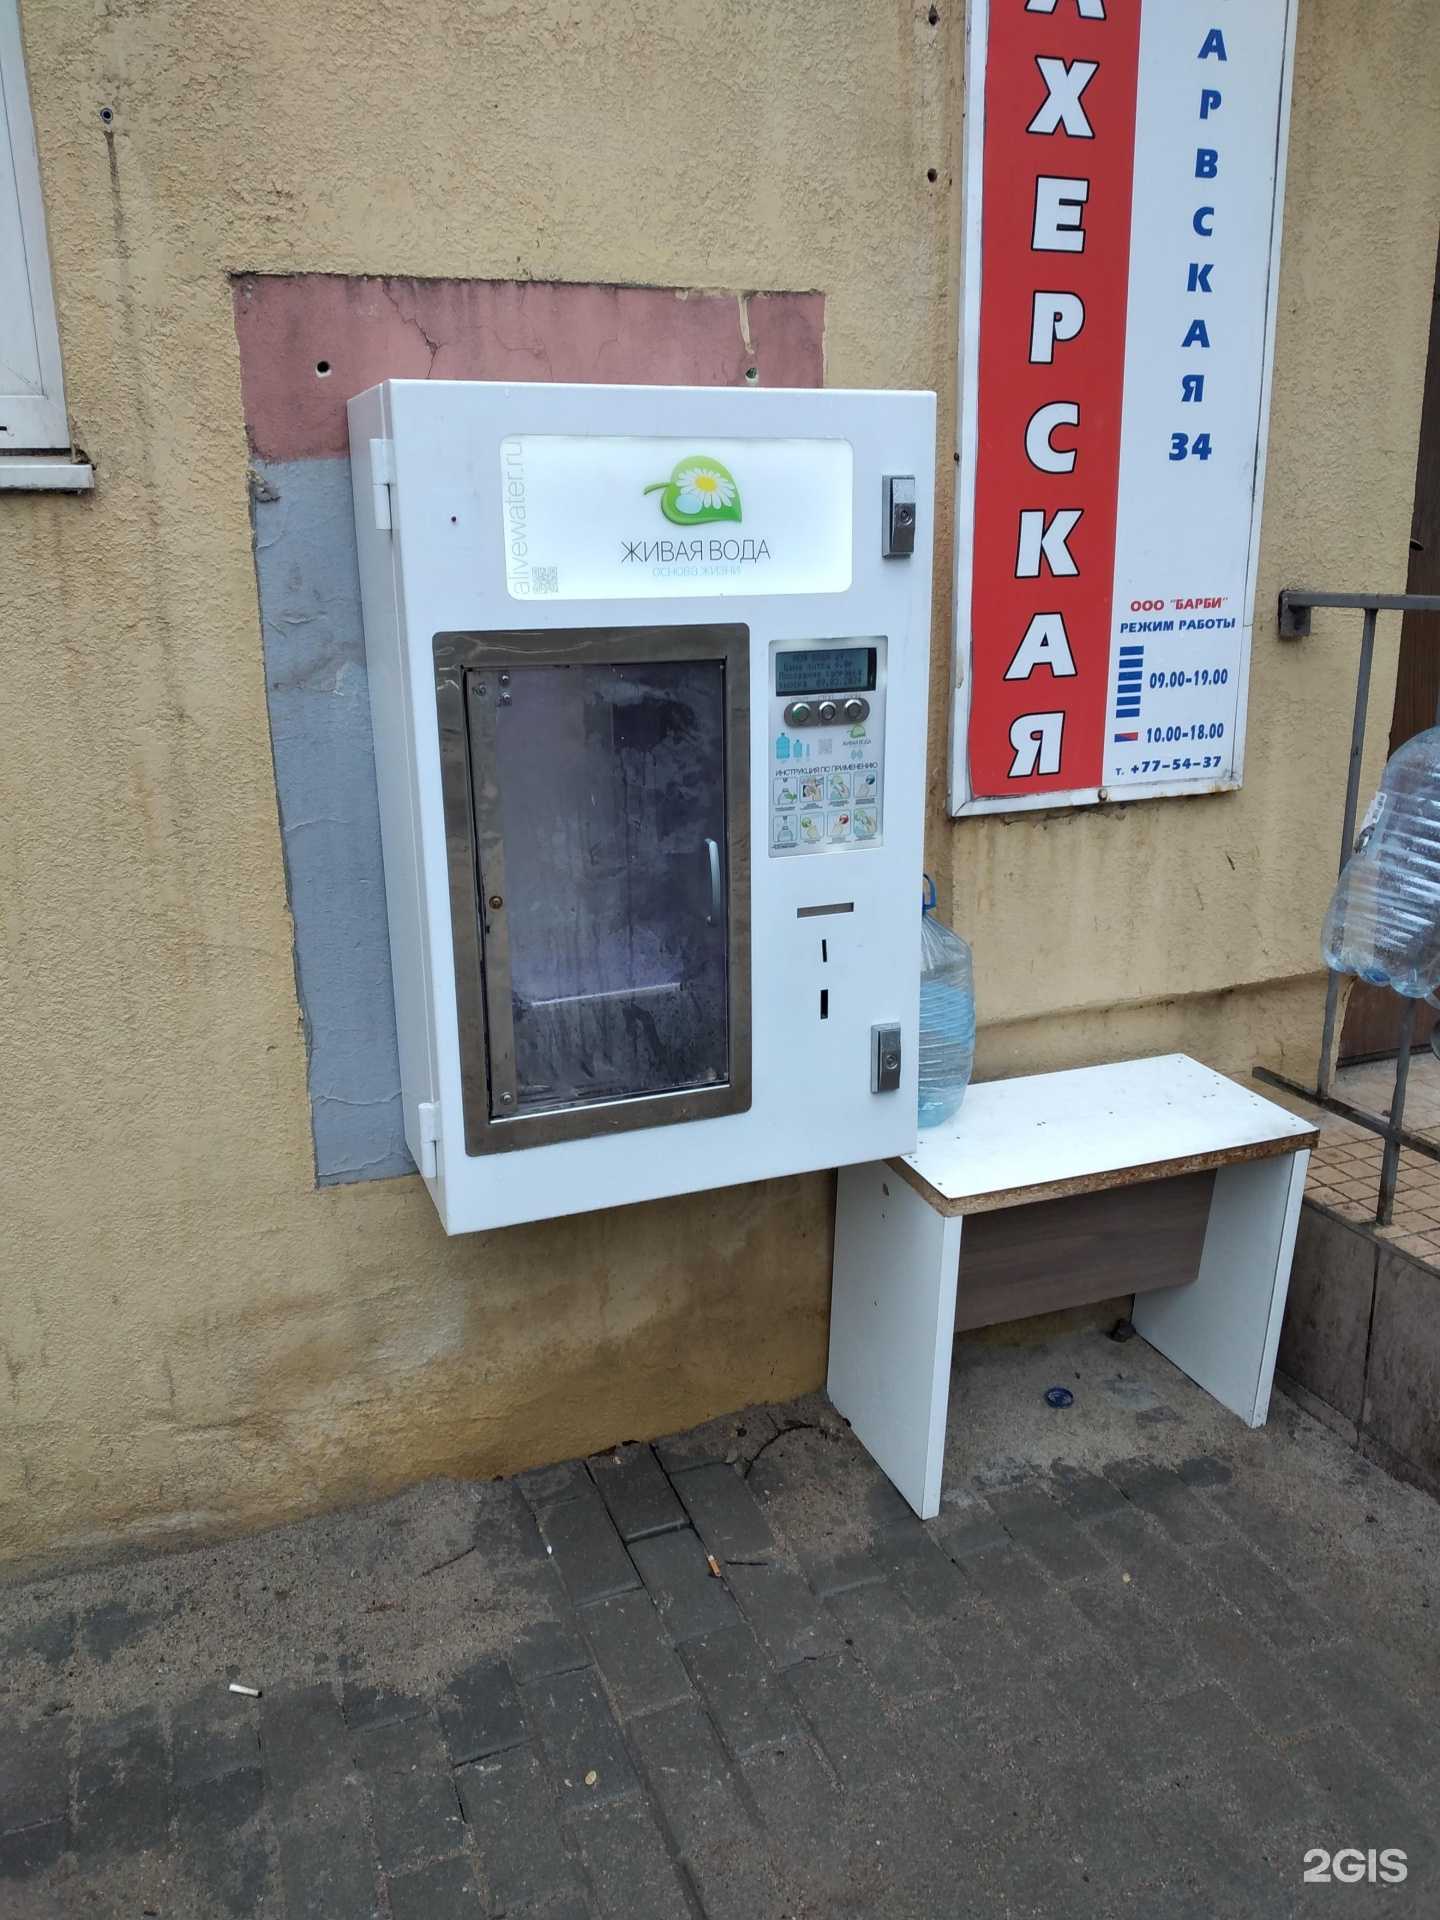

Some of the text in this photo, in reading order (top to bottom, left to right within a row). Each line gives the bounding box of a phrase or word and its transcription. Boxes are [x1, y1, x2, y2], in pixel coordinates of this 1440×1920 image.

[1181, 29, 1228, 403] АРВСКАЯ
[1003, 0, 1107, 778] ХЕРСКАЯ
[1169, 433, 1212, 461] 34
[506, 440, 531, 595] alivewater.ru
[621, 538, 772, 564] ЖИВАЯ ВОДА
[1130, 597, 1229, 612] ООО "БАРБИ"
[1120, 617, 1236, 634] РЕЖИМ РАБОТЫ
[1149, 668, 1229, 689] 09.00-19.00
[1146, 722, 1225, 744] 10.00-18.00
[775, 766, 819, 777] ИНСТРУКЦИЯ
[831, 762, 879, 773] ПРИМЕНЕНИЮ
[1131, 755, 1222, 775] +77-54-37
